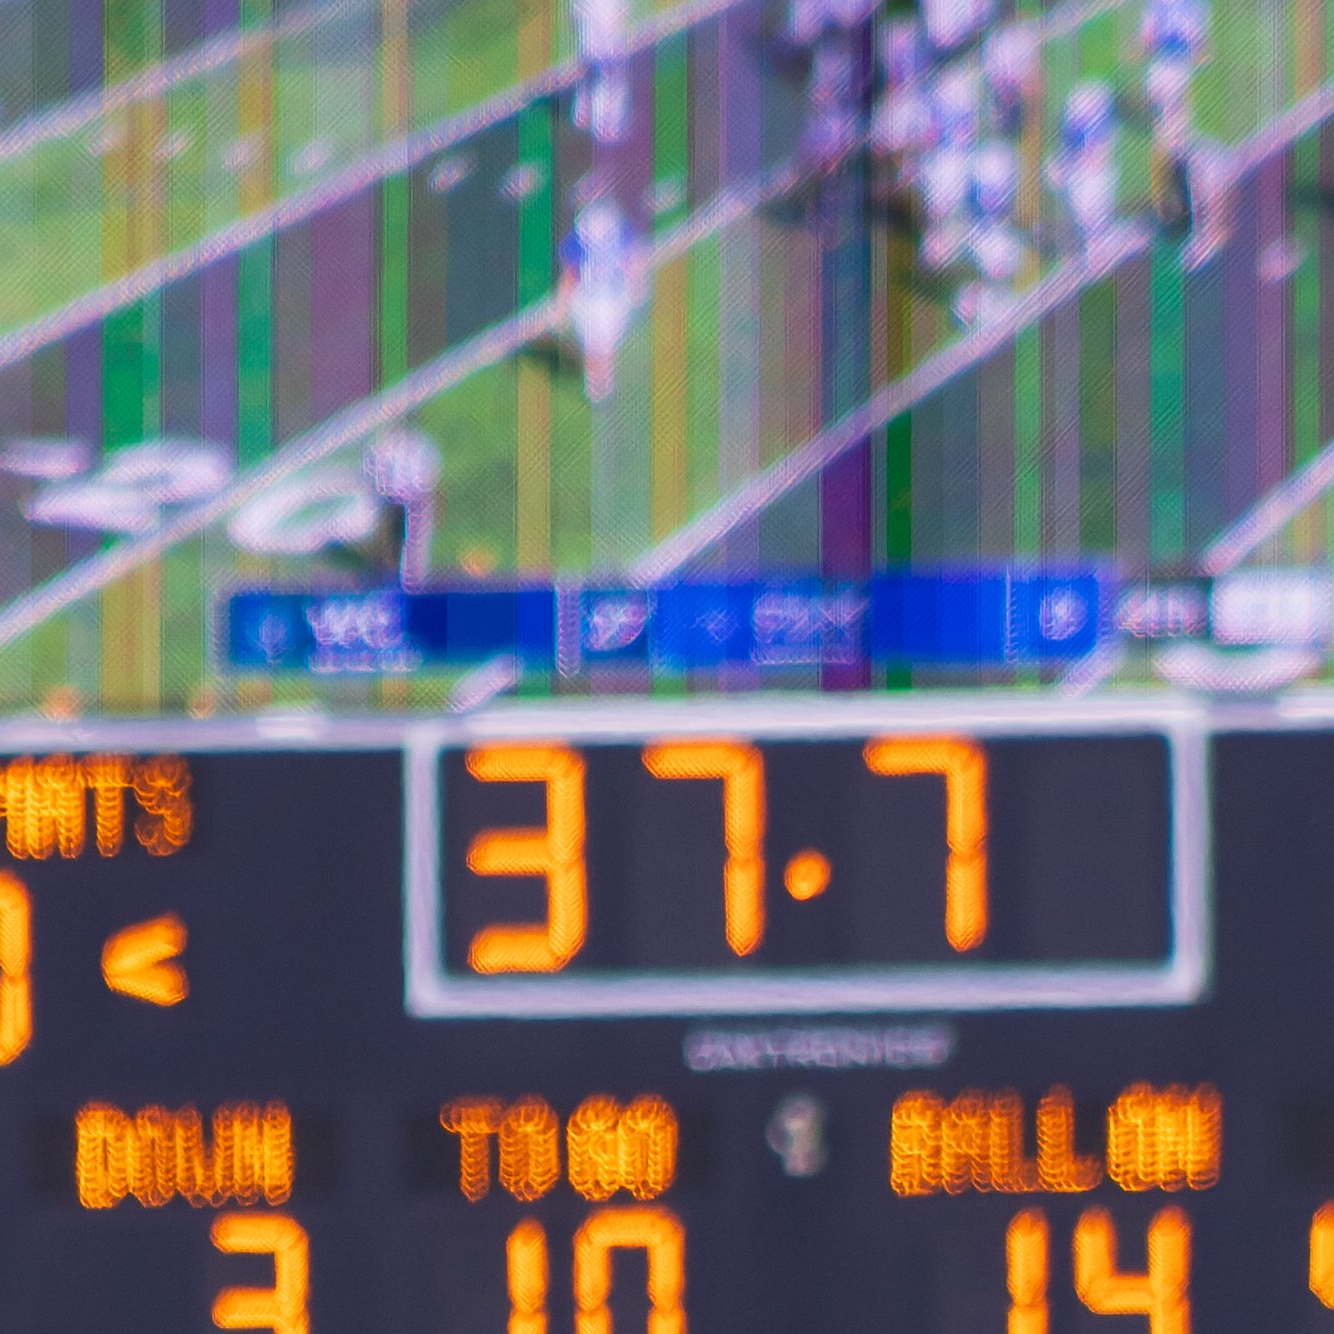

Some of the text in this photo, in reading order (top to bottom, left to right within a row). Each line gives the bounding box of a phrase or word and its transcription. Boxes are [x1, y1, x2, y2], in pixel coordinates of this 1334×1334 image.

[465, 732, 988, 974] 37.7
[75, 1103, 294, 1212] DOWN
[440, 1096, 678, 1206] TO GO
[890, 1084, 1221, 1197] BALL ON
